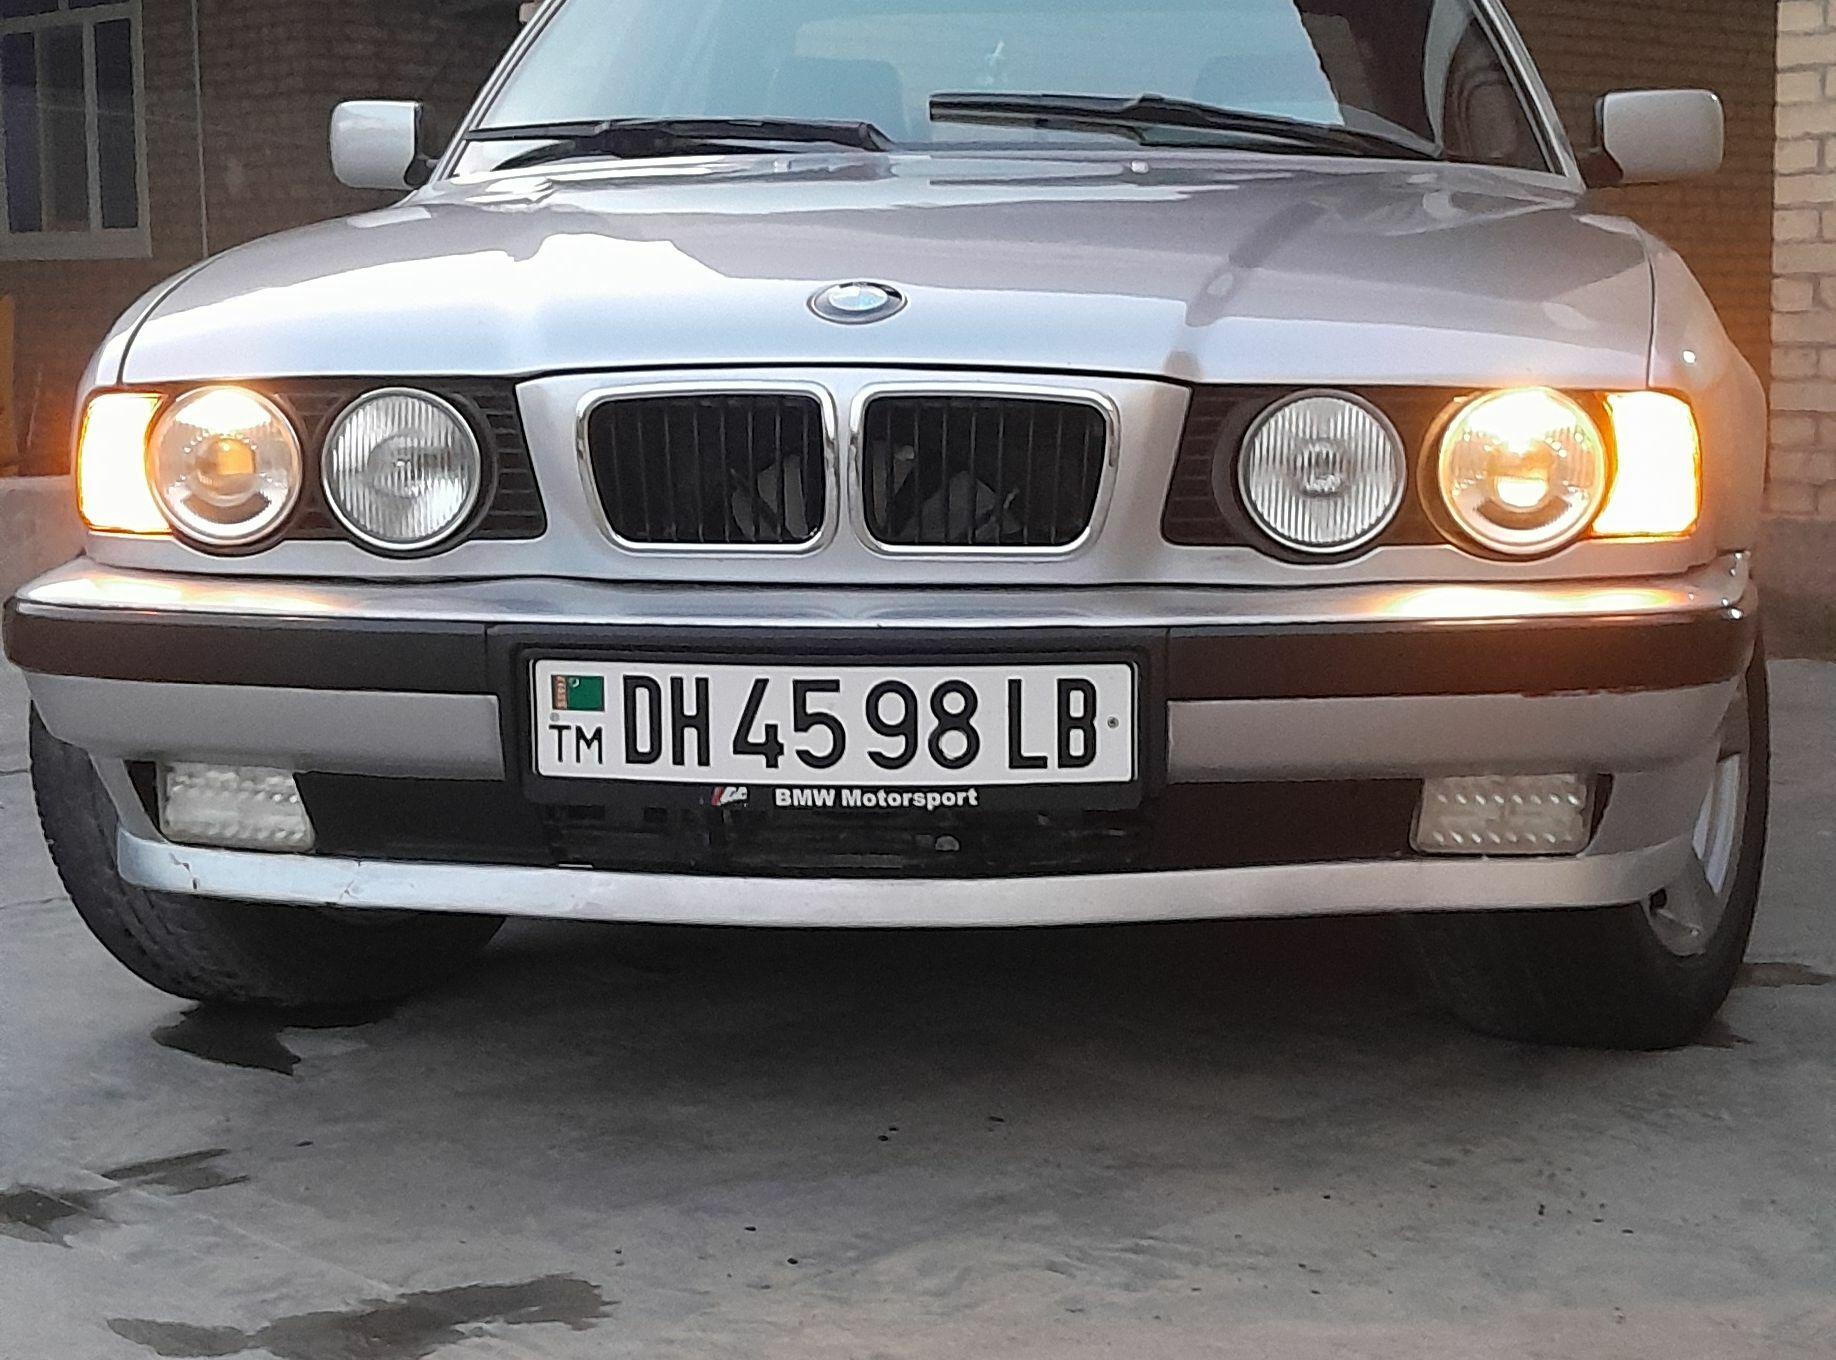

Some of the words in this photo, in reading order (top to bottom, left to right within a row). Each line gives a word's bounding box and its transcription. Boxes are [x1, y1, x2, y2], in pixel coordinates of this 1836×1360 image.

[622, 674, 711, 767] DH
[1007, 678, 1097, 770] LB
[548, 724, 603, 765] TM
[775, 788, 836, 807] BMW
[841, 788, 978, 811] Motorsport
